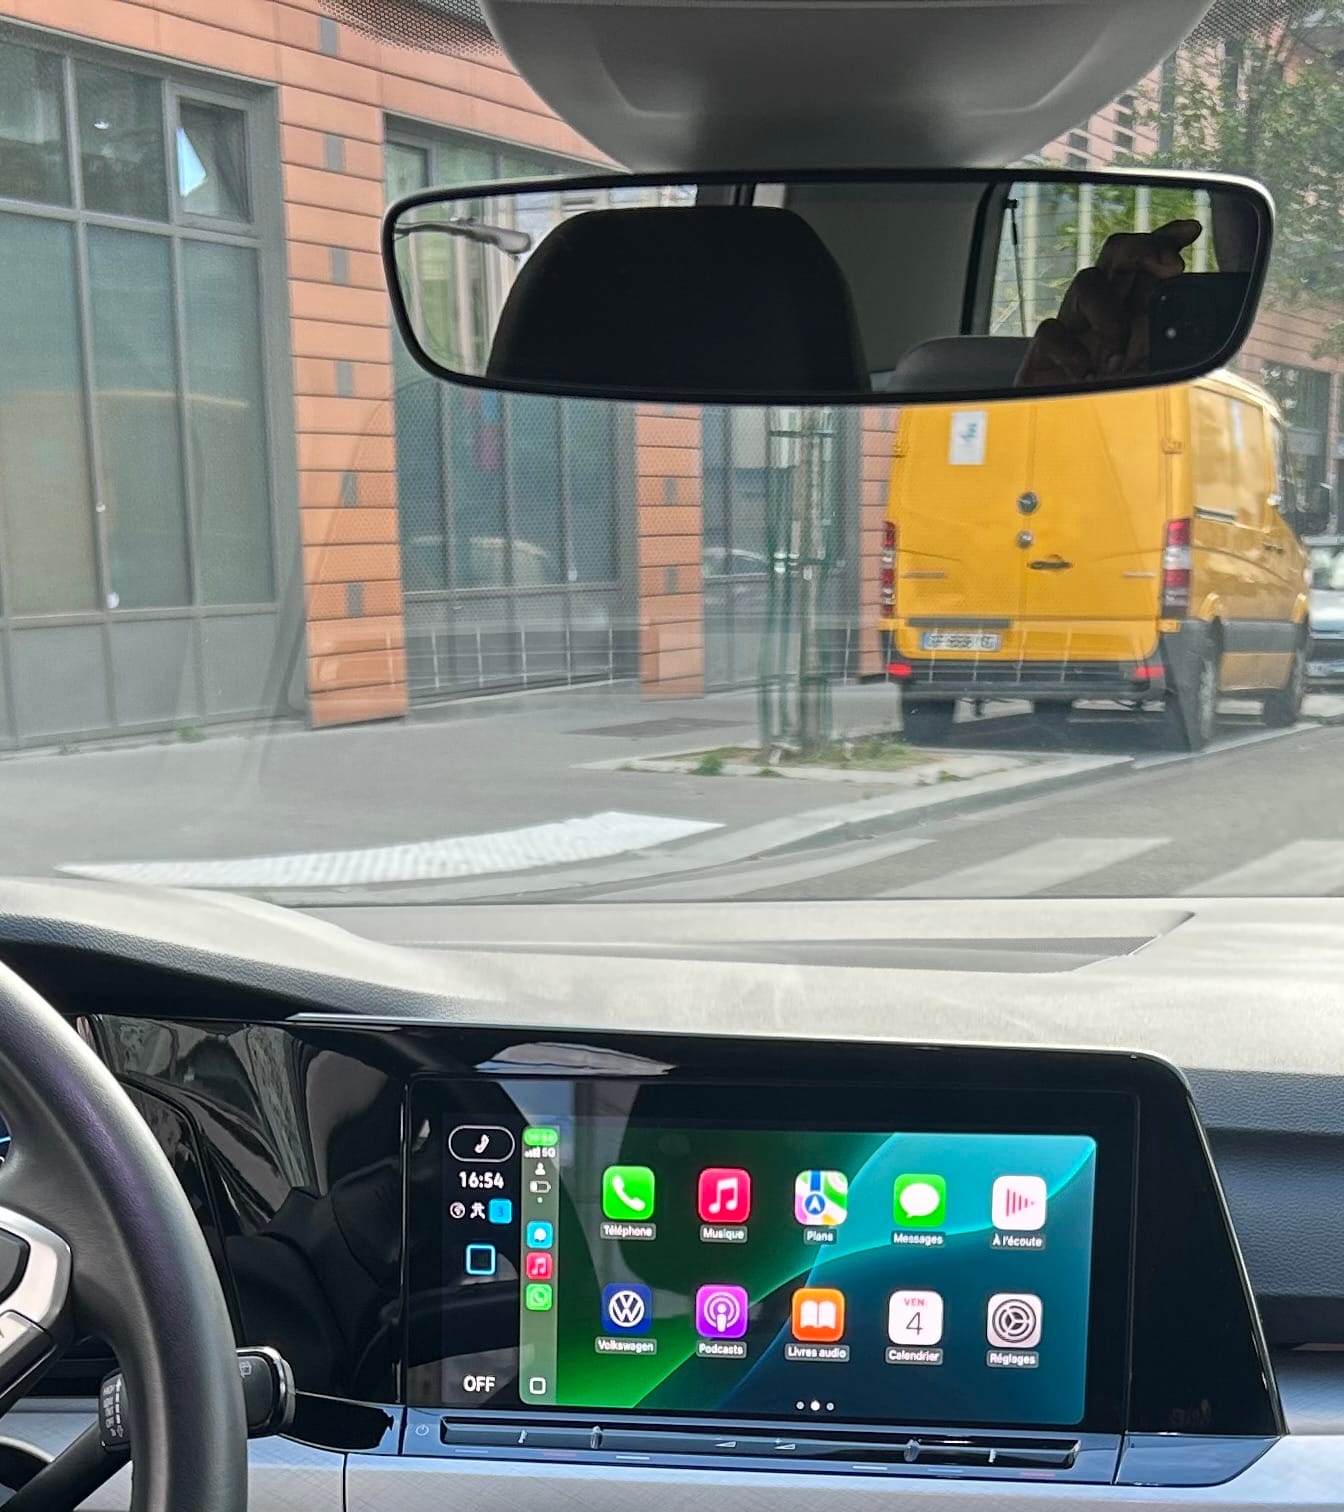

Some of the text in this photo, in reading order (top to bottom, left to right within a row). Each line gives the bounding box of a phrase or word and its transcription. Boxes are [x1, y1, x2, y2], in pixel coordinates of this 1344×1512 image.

[458, 1171, 505, 1189] 16:54
[603, 1224, 652, 1238] Téléphone
[703, 1227, 745, 1241] Musique
[807, 1231, 834, 1242] Plans
[893, 1233, 944, 1246] Messages
[1005, 1235, 1043, 1247] l'écoute
[904, 1297, 928, 1307] VEN.
[905, 1311, 923, 1335] 4
[597, 1339, 654, 1354] Volkswagen
[698, 1343, 744, 1356] Podcasts
[788, 1346, 847, 1358] Livres audio
[888, 1349, 940, 1362] Calendrier
[989, 1352, 1036, 1365] Réglages
[463, 1375, 496, 1392] OFF
